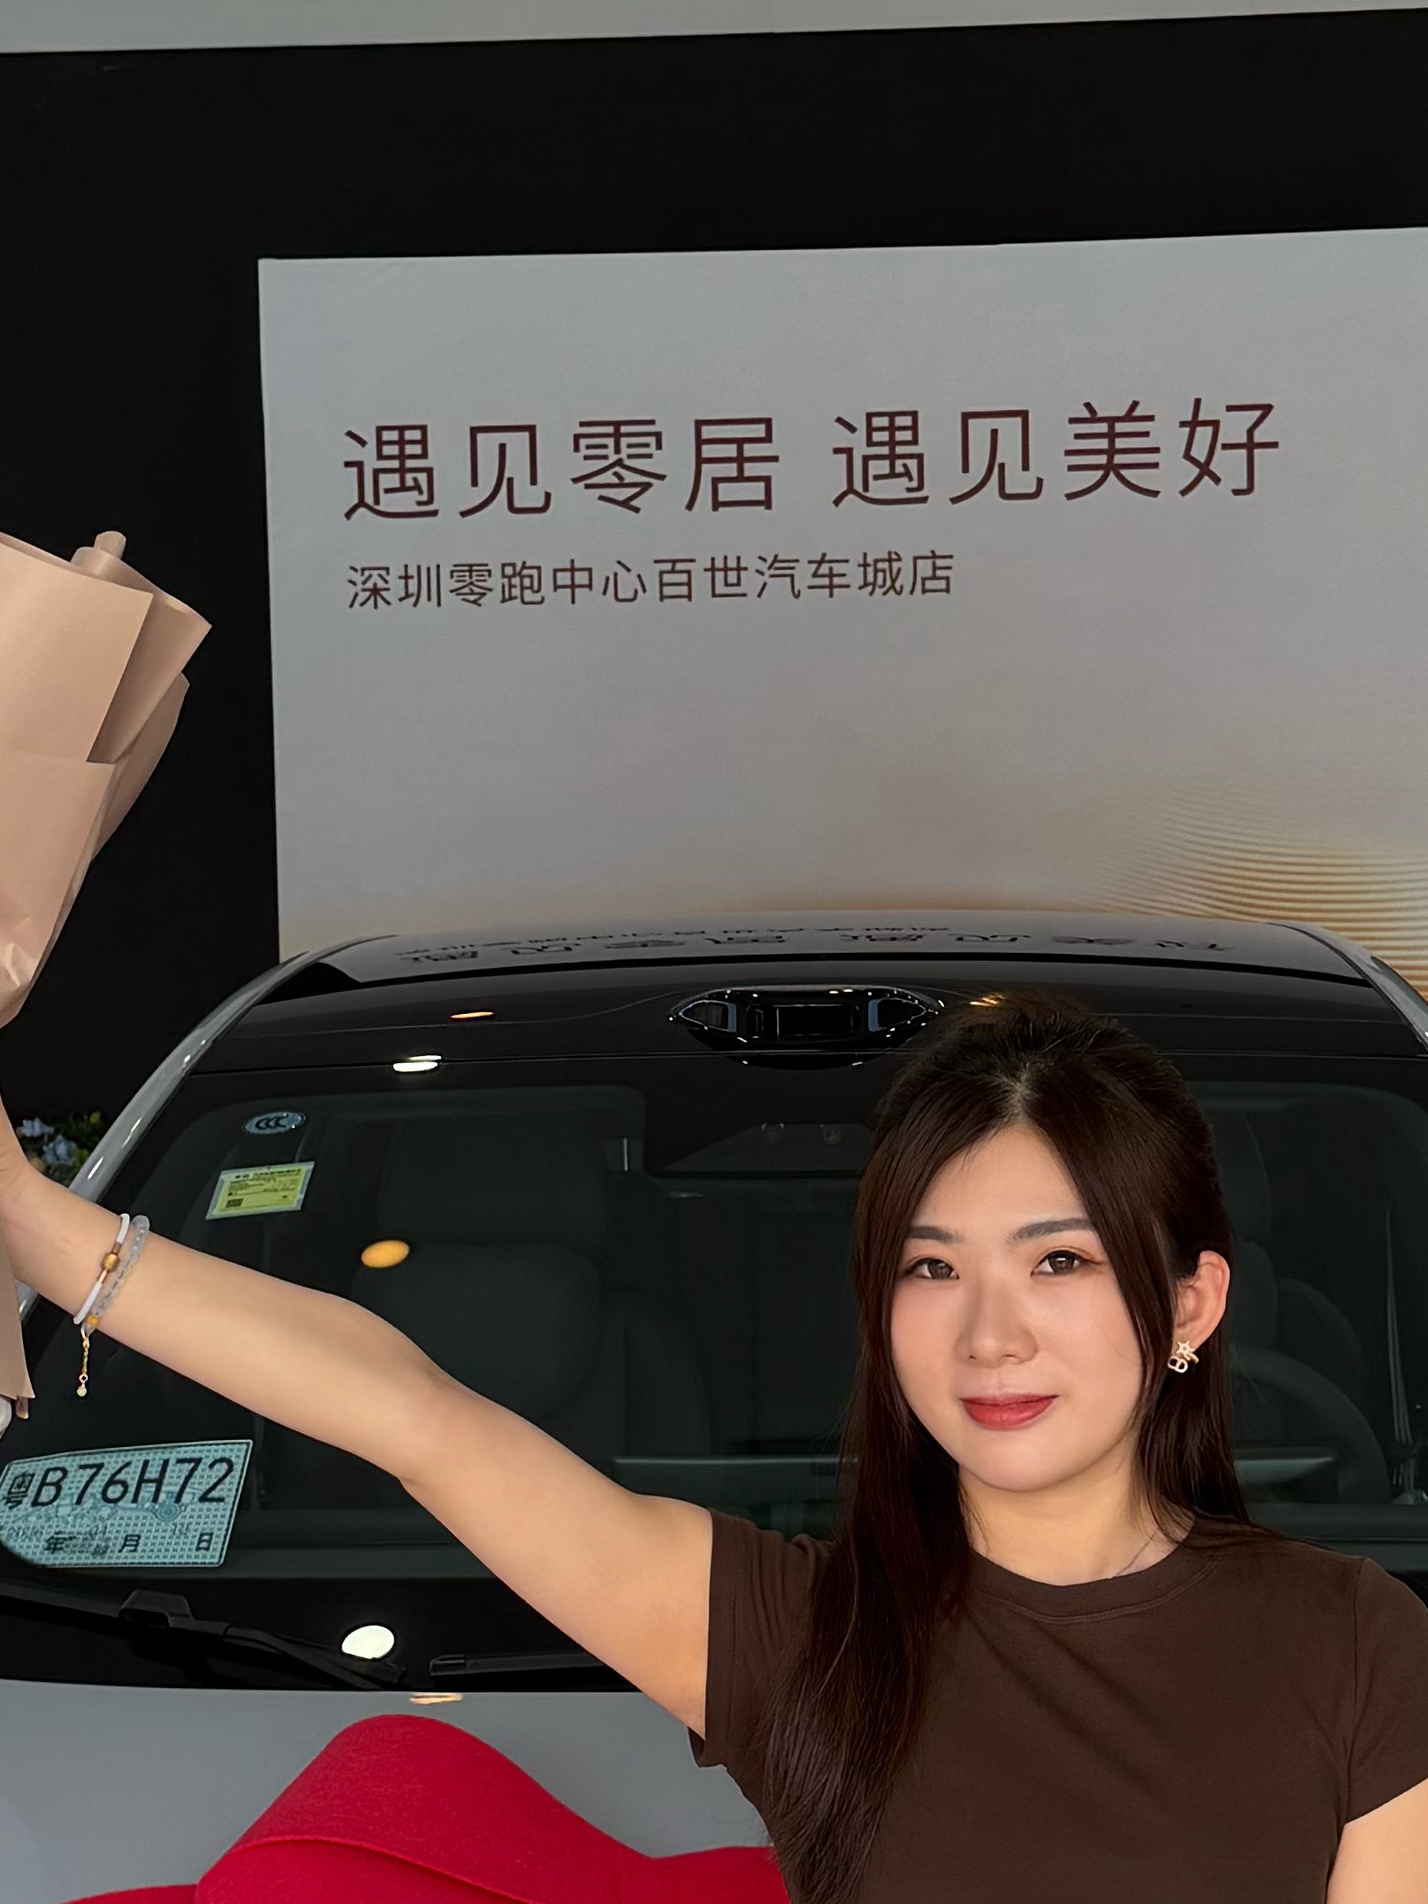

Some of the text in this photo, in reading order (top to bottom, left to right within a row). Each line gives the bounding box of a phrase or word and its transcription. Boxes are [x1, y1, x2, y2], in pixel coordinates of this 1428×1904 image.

[342, 396, 1280, 522] 遇见零居 遇见美好
[346, 549, 955, 611] 深圳零跑中心百世汽车城店
[1, 1455, 235, 1511] 粤B76H72
[118, 1533, 142, 1554] 月
[194, 1531, 214, 1552] 日
